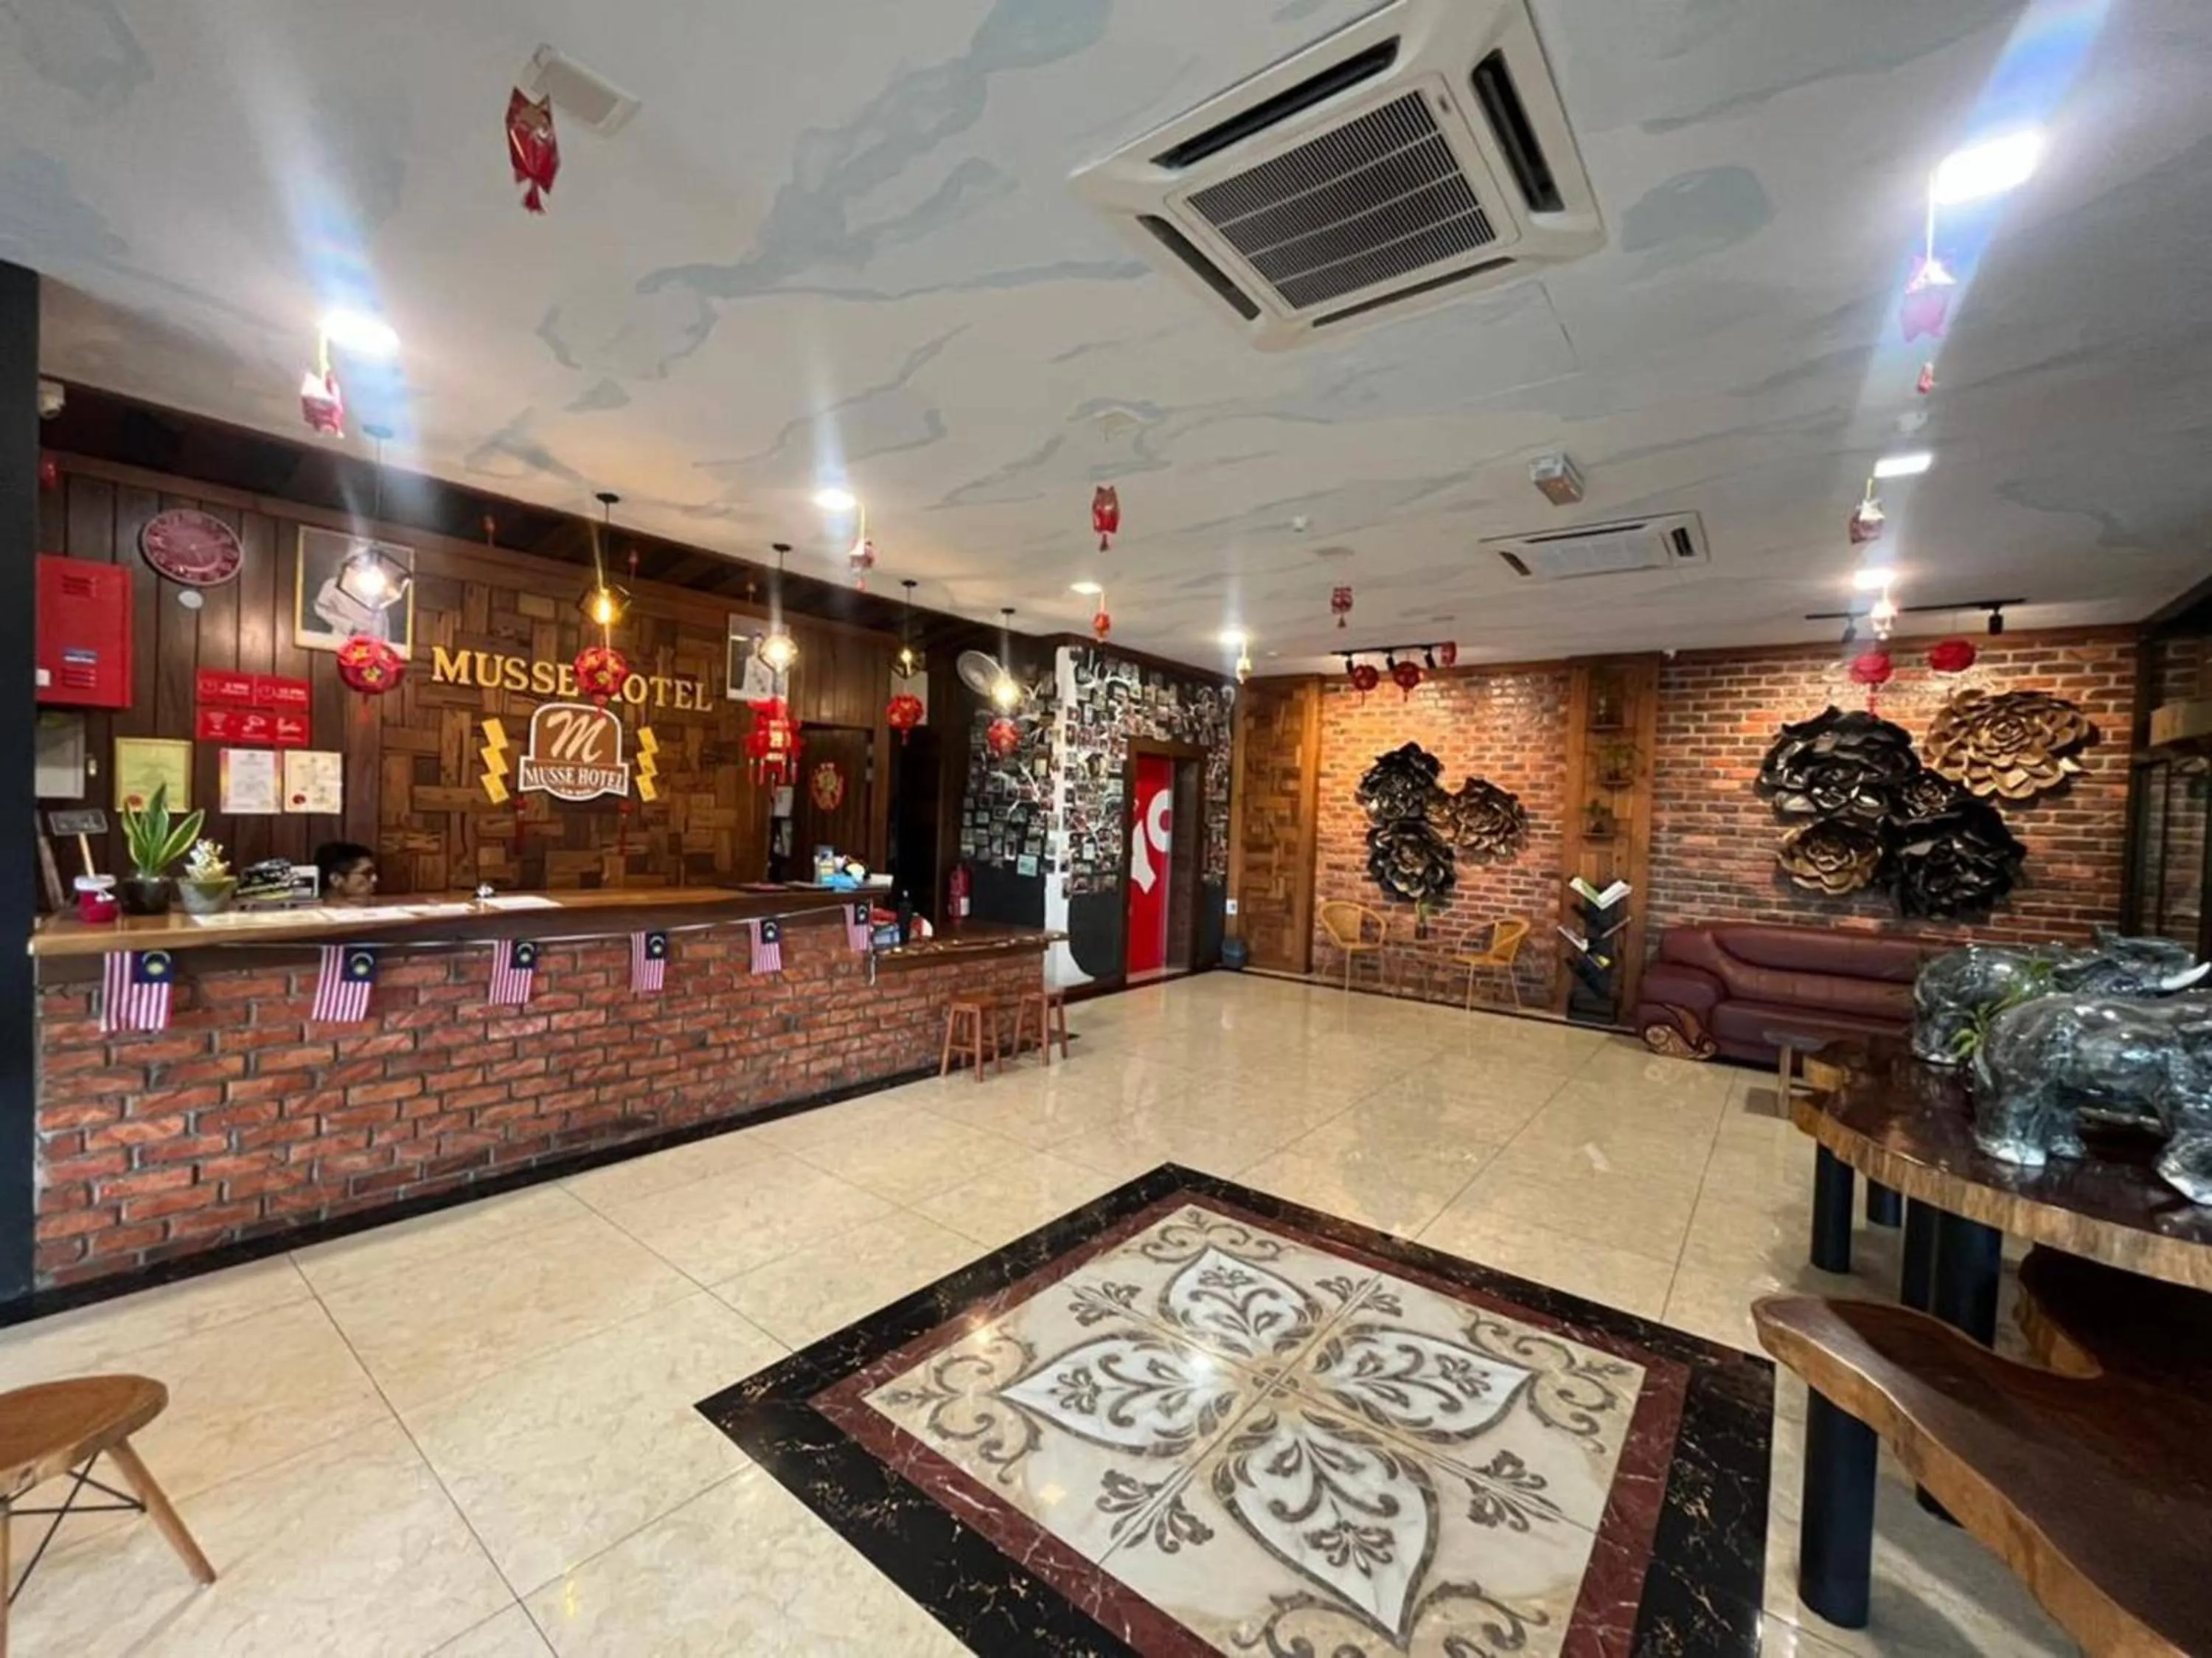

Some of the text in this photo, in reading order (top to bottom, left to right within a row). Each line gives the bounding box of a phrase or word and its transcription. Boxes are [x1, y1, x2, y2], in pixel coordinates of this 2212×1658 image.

[431, 646, 713, 712] MUSSE OTEL
[525, 766, 622, 789] MUSSE HOTEL
